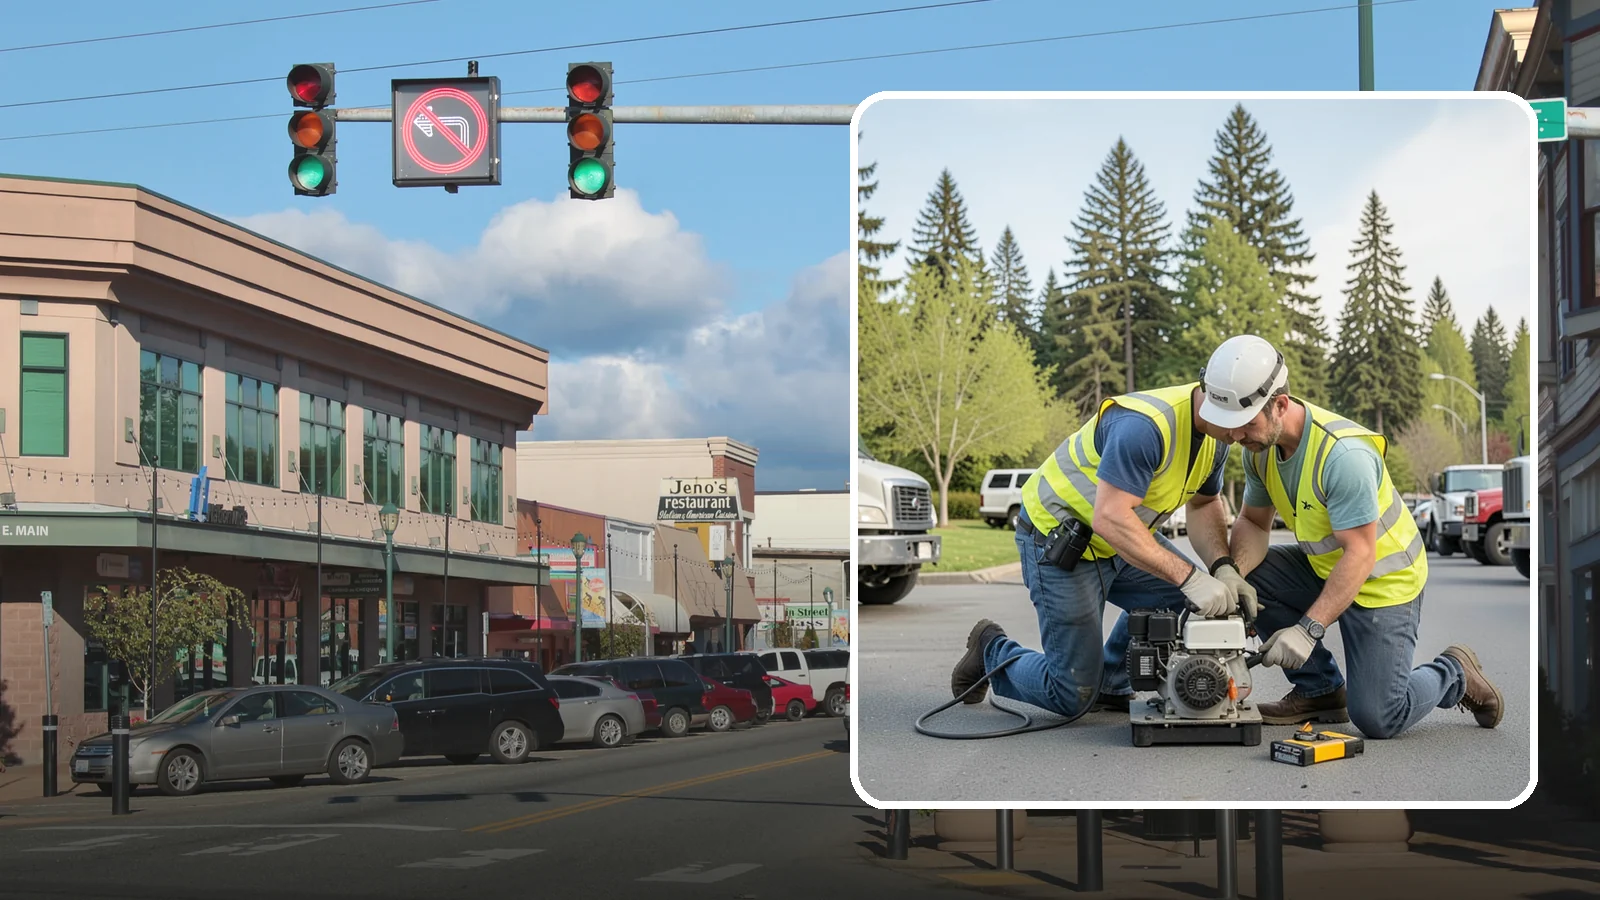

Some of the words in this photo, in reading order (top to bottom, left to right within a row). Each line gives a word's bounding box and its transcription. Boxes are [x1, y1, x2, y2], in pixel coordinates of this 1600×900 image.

[669, 480, 727, 494] Jeno's
[665, 496, 731, 509] restaurant
[658, 509, 681, 520] Italian
[686, 509, 714, 519] American
[715, 509, 738, 519] Cuisine
[2, 525, 13, 536] E.
[15, 525, 49, 536] MAIN
[797, 607, 828, 617] Street
